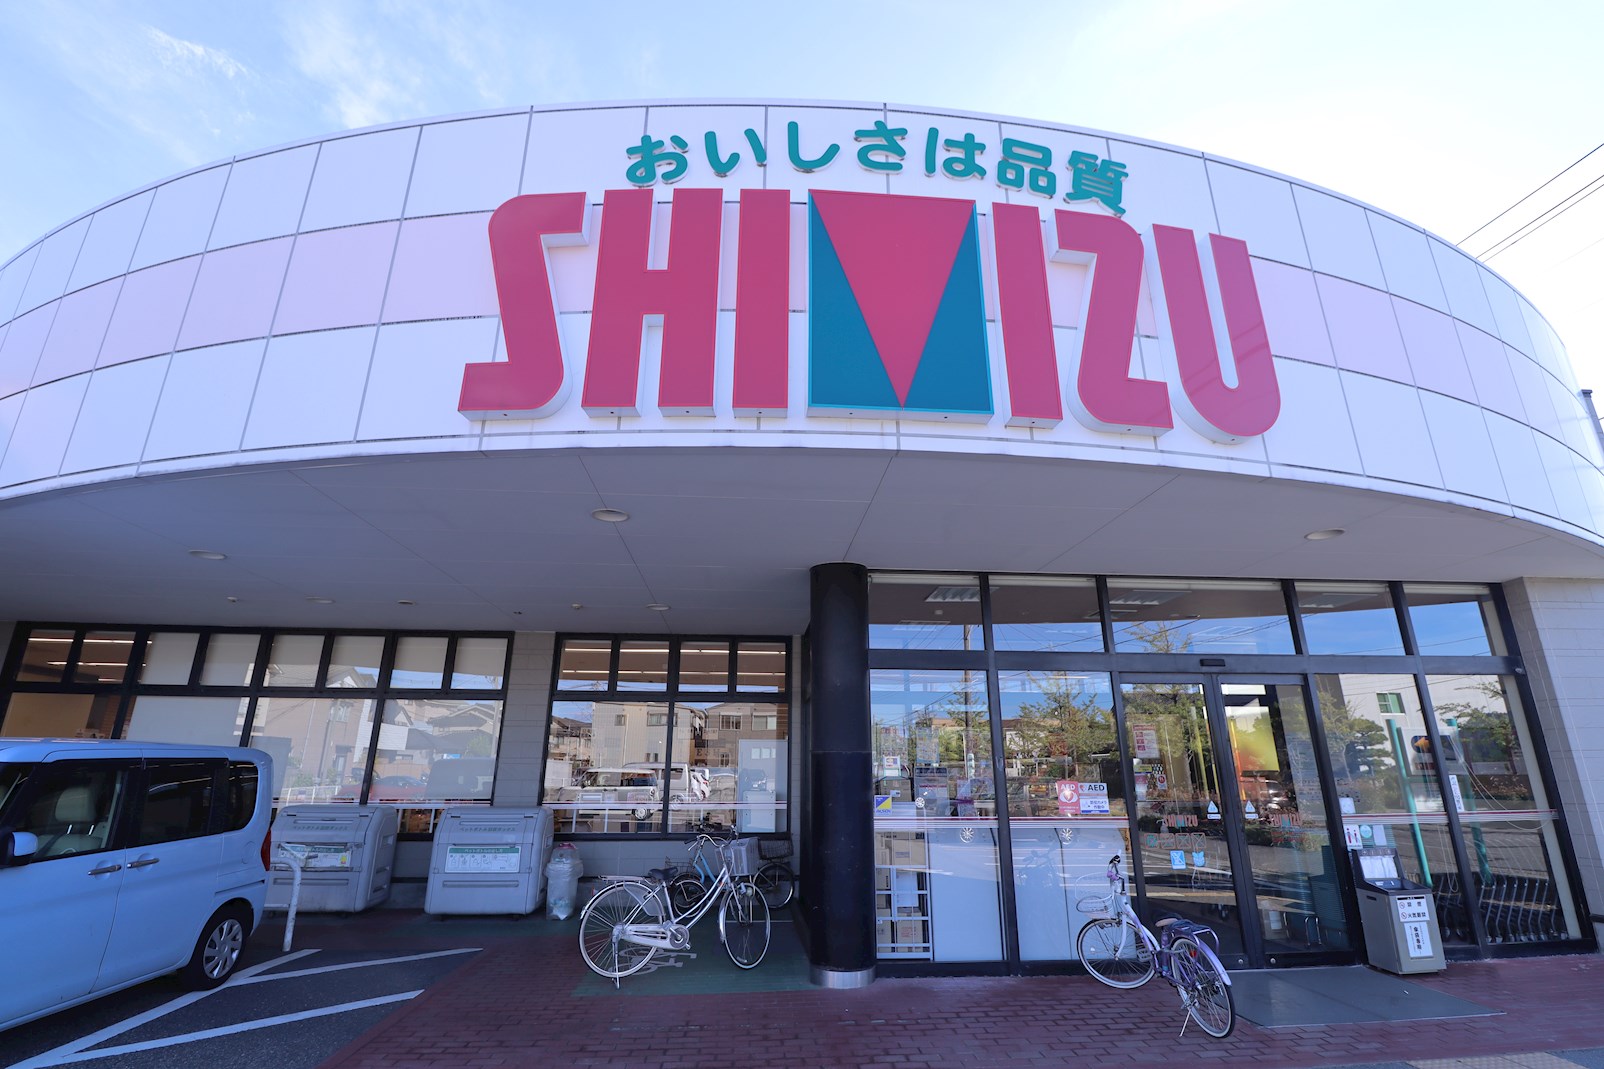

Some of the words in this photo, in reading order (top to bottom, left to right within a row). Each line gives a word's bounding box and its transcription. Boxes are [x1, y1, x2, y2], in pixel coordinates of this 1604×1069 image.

[625, 120, 1128, 217] おいしさは品質
[457, 187, 1283, 441] SHIMIZU
[1061, 783, 1076, 791] AED
[1163, 814, 1199, 828] SHIMIZU
